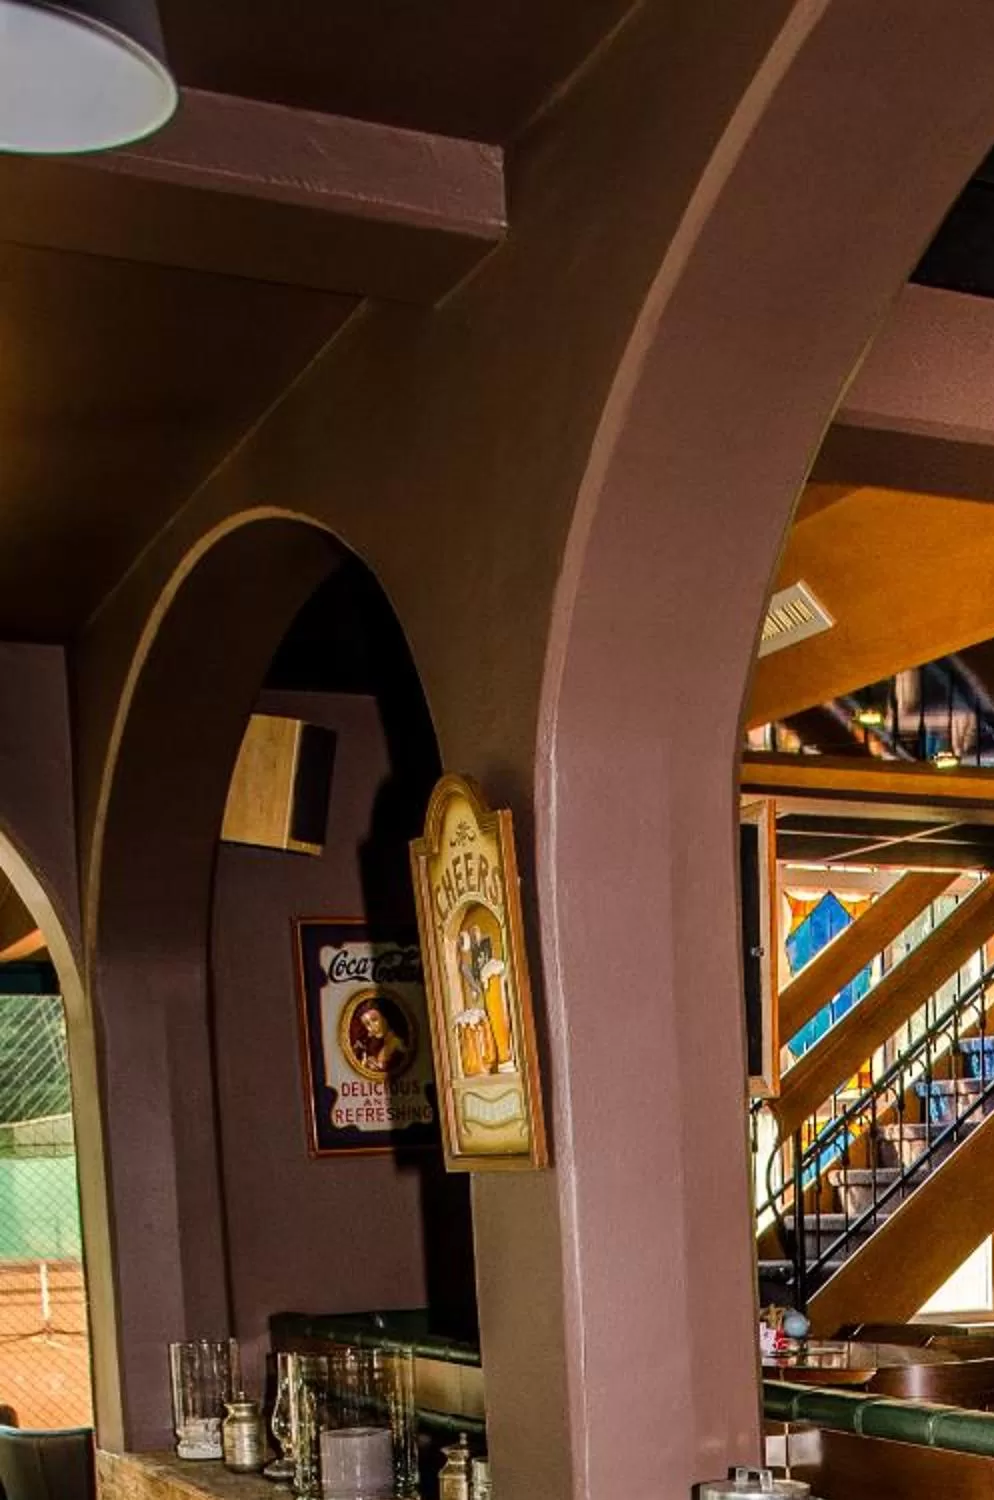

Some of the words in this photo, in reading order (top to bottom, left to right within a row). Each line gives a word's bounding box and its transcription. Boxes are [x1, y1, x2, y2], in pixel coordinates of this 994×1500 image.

[434, 852, 502, 920] CHEERS
[341, 1081, 421, 1097] DELICIOUS
[335, 1105, 433, 1123] REFRESHING
